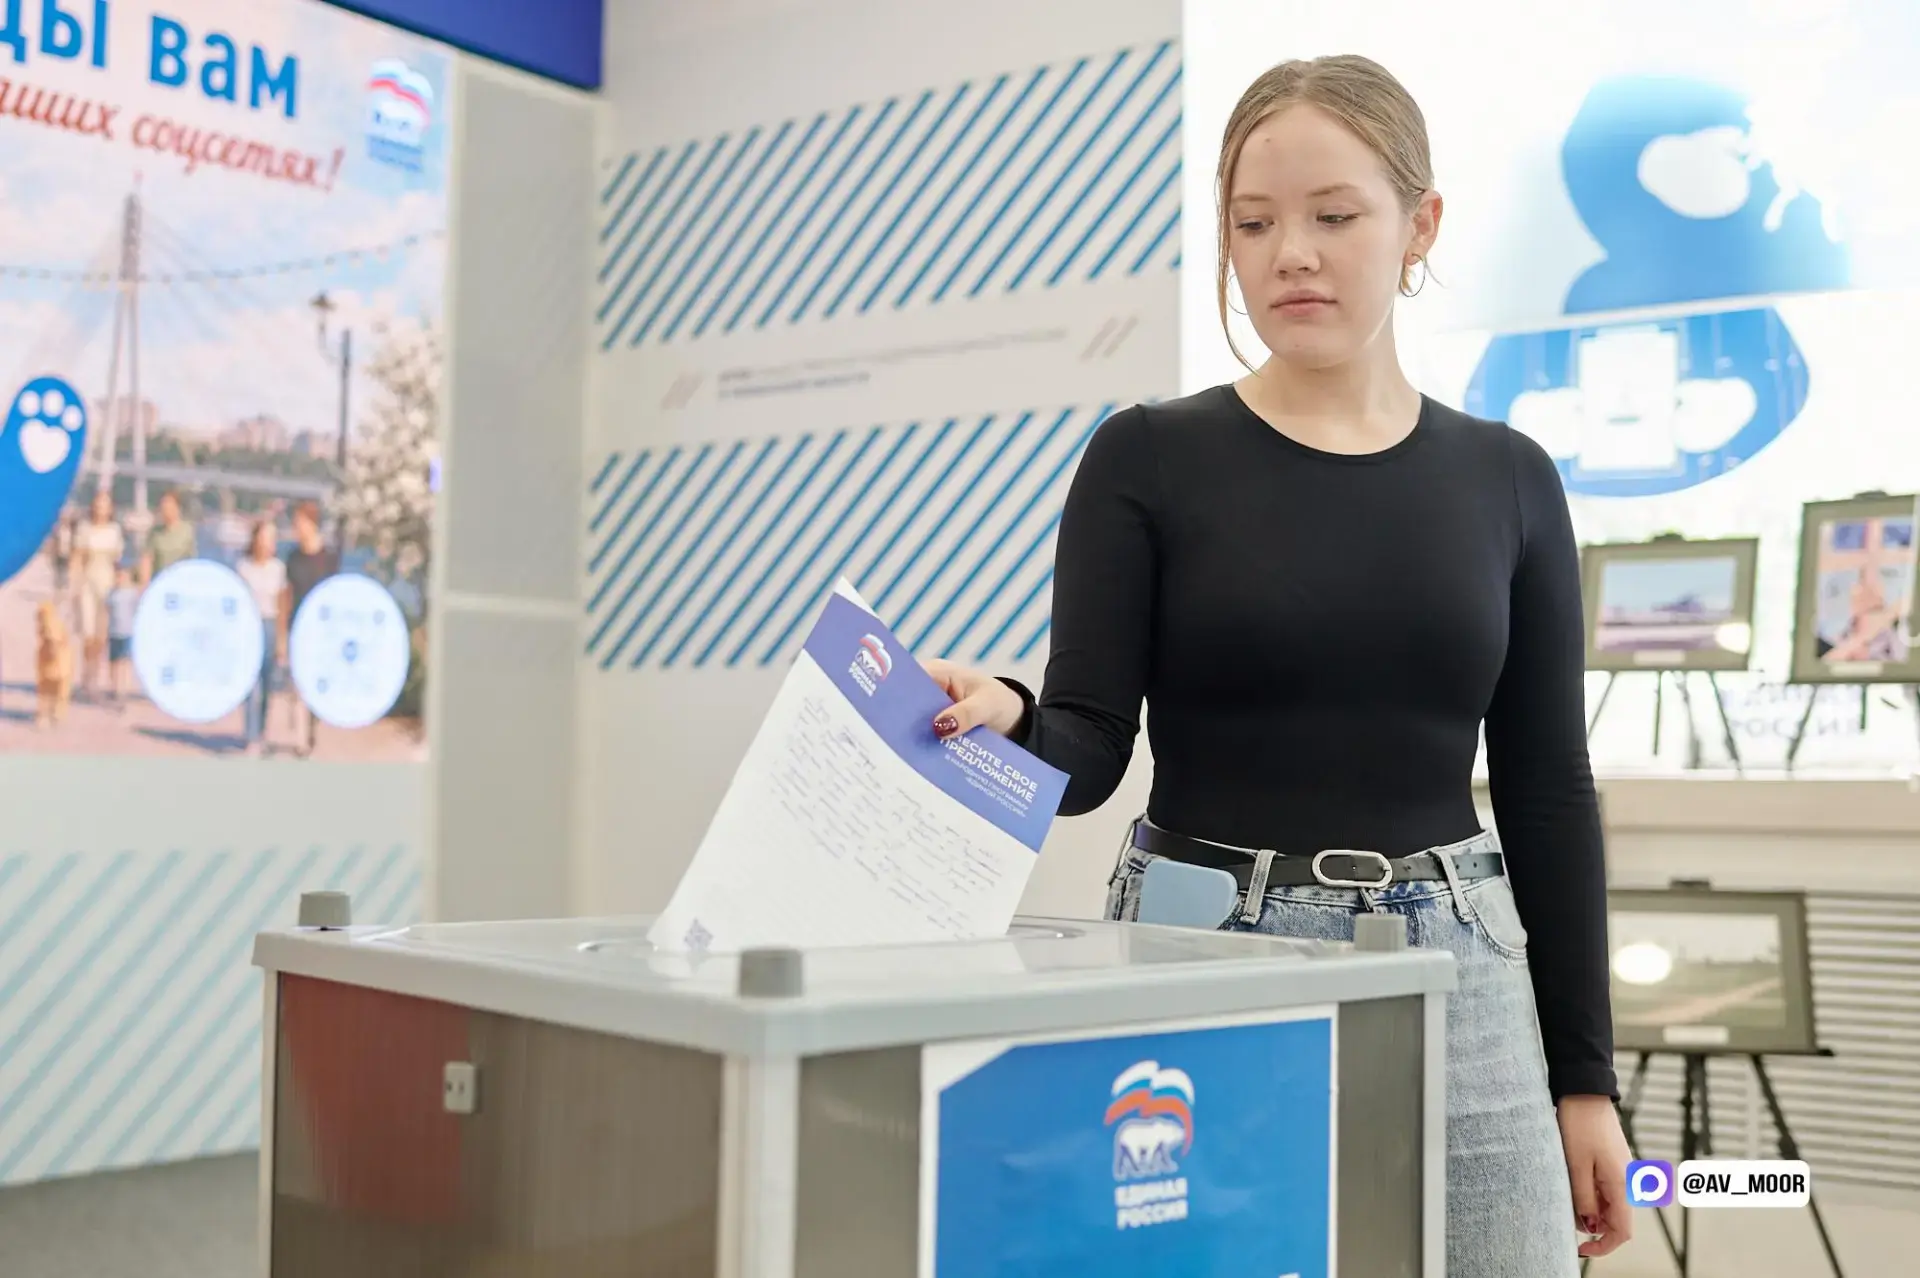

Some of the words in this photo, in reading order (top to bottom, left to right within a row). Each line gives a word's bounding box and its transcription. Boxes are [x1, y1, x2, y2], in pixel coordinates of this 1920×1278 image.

[150, 15, 296, 117] вам
[0, 81, 119, 138] ших
[132, 114, 346, 194] соцсетях!
[940, 738, 1034, 803] ПРЕДЛОЖЕНИЕ
[1003, 764, 1037, 792] СВОЕ
